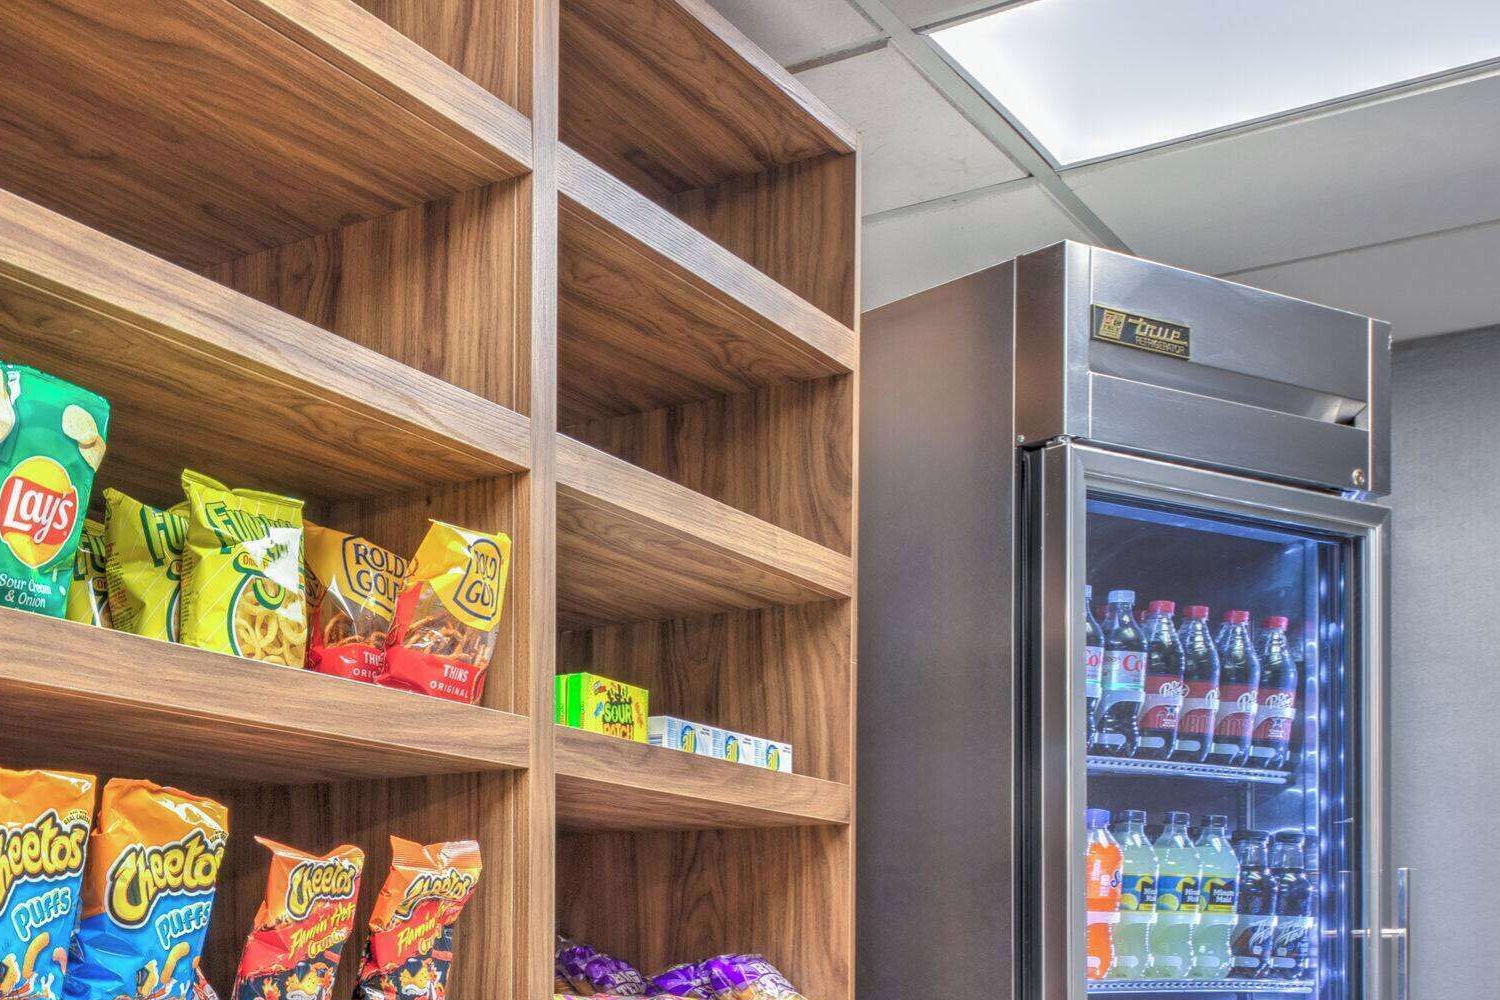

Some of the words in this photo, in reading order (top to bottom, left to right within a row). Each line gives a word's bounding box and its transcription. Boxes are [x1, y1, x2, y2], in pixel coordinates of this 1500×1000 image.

[2, 478, 74, 544] Lay's
[353, 543, 405, 578] ROLD
[28, 581, 53, 596] Cream
[4, 591, 15, 603] &
[18, 593, 46, 609] Onion
[443, 664, 469, 683] THINS
[429, 680, 469, 699] ORIGINAL
[603, 702, 633, 724] SOUR
[287, 858, 355, 919] Cheetos
